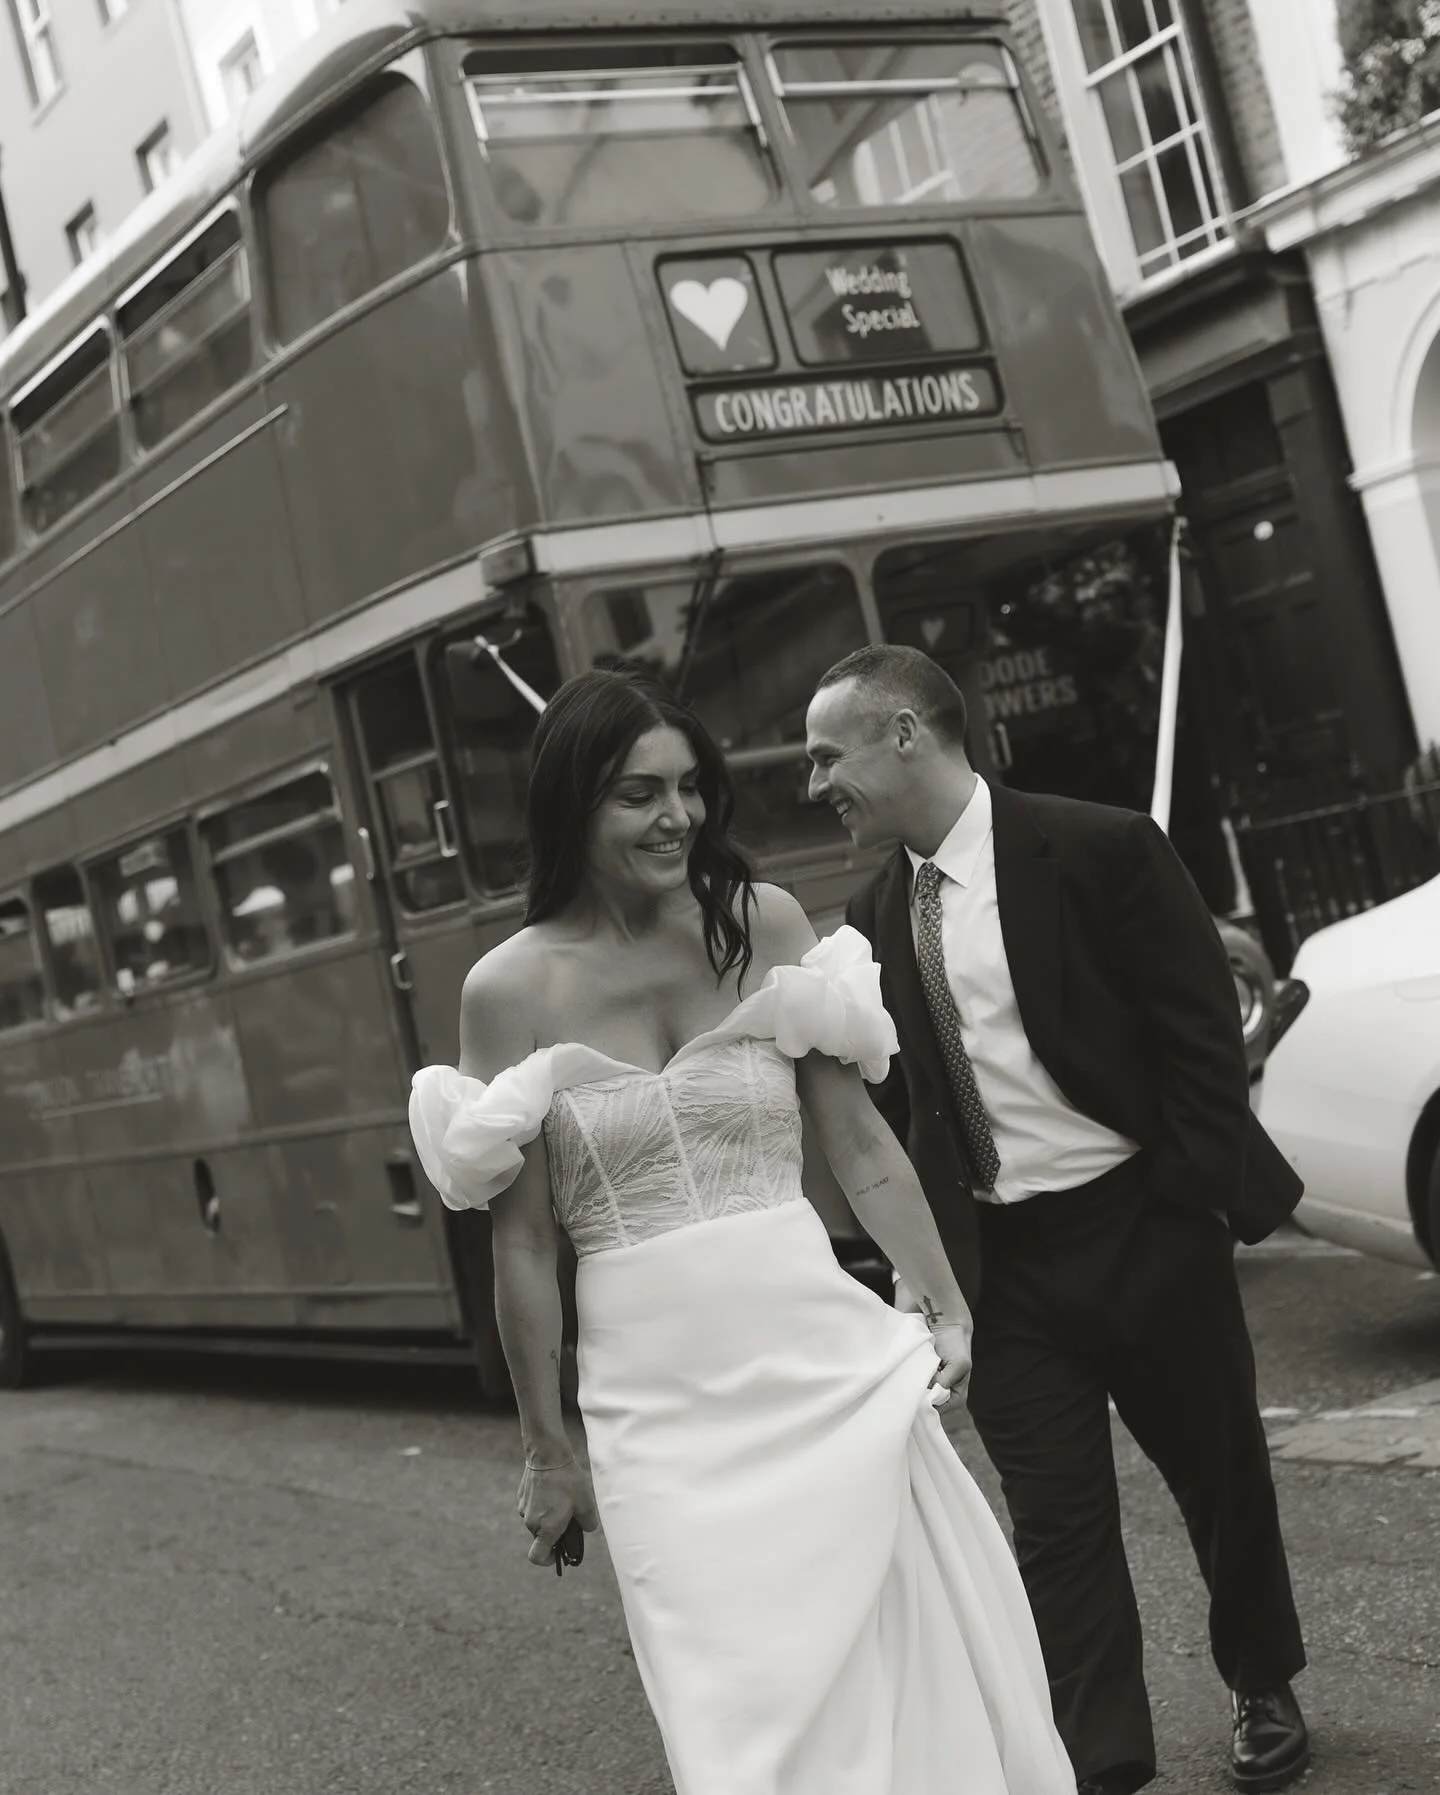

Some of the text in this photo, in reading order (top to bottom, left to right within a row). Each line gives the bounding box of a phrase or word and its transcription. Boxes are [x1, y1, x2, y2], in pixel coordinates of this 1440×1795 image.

[825, 266, 912, 299] Wedding
[841, 301, 921, 339] Special
[714, 372, 980, 433] CONGRATULATIONS
